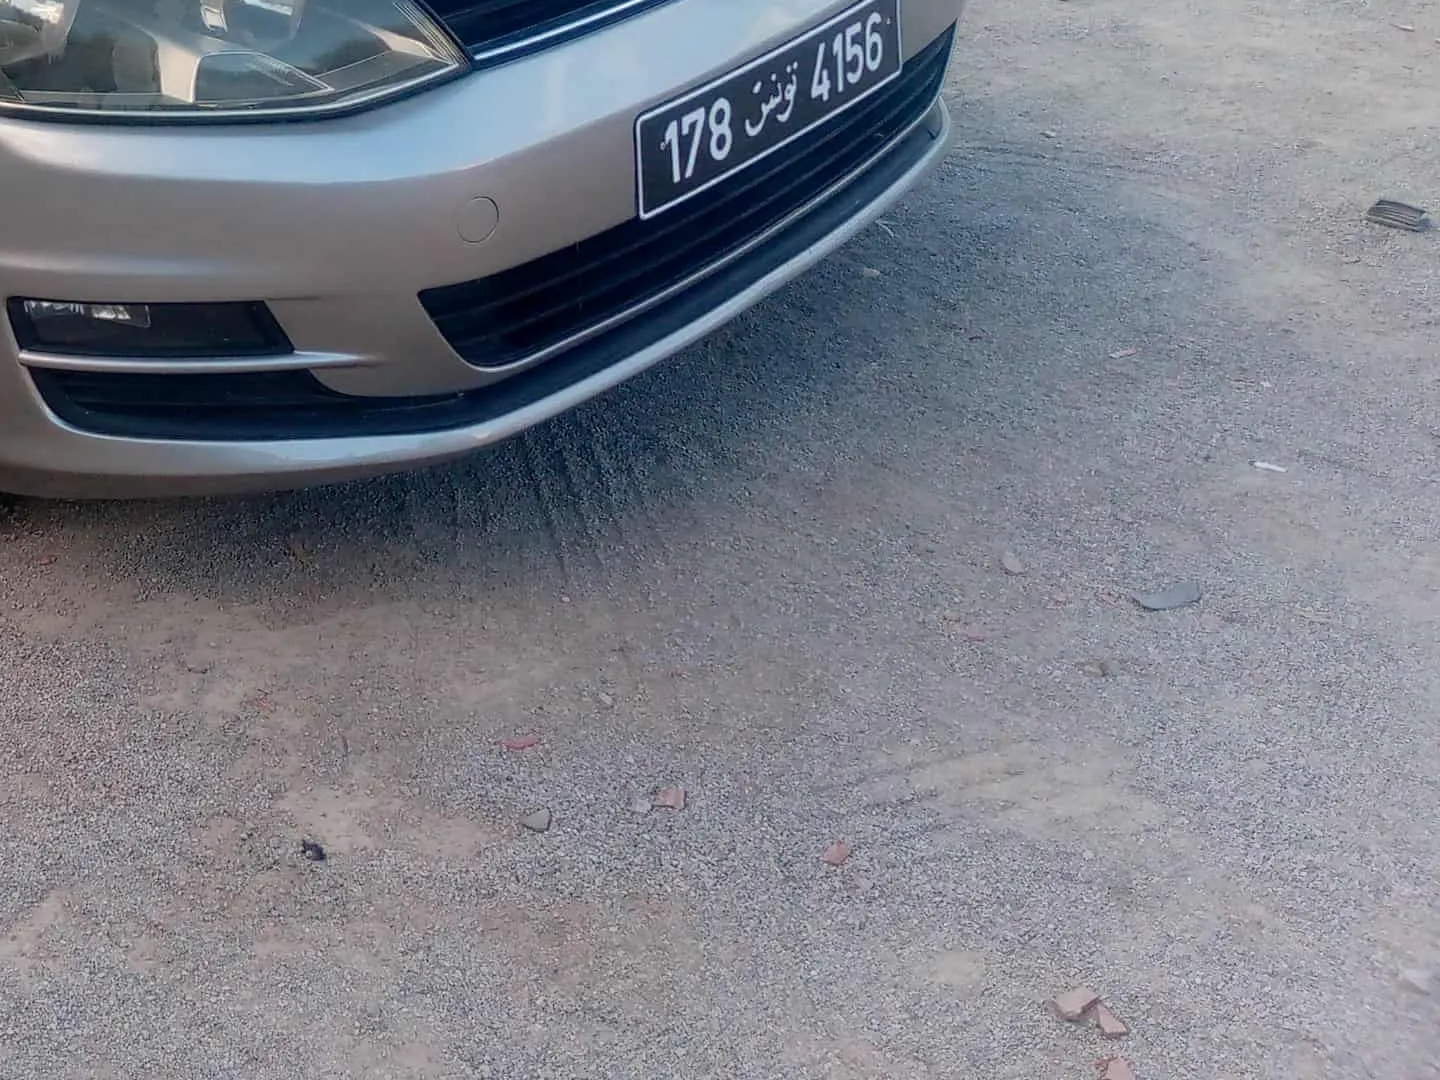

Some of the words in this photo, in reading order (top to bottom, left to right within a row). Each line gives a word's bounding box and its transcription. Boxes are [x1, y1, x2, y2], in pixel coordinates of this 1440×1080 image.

[664, 97, 733, 184] 178
[744, 61, 799, 137] تونس
[810, 12, 884, 102] 4156
